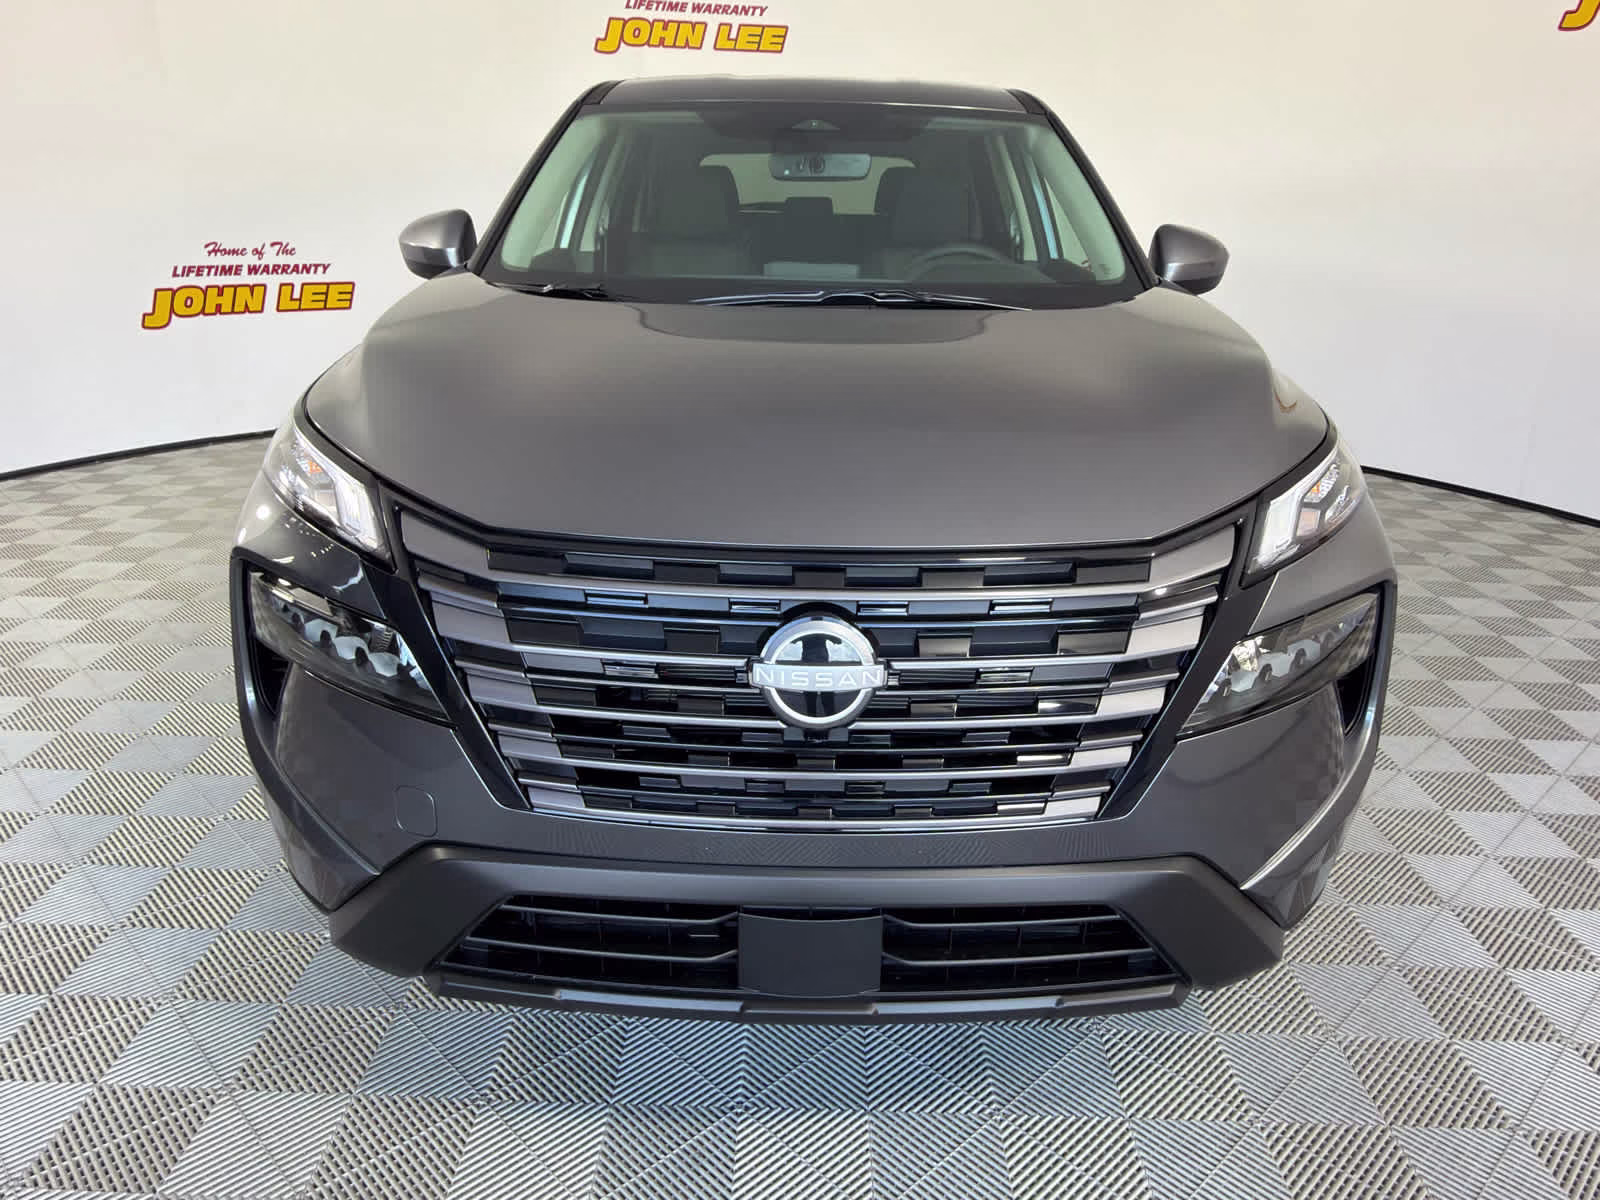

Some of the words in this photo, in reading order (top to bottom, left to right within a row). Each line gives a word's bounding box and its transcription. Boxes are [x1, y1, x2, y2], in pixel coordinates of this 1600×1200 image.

[624, 0, 688, 13] LIFETIME
[691, 3, 768, 17] WARRANTY
[594, 17, 708, 54] JOHN
[713, 22, 789, 54] LEE
[203, 241, 248, 257] Home
[251, 243, 266, 261] of
[269, 241, 297, 257] The
[171, 264, 244, 278] LIFETIME
[247, 263, 332, 276] WARRANTY
[141, 283, 267, 330] JOHN
[276, 281, 355, 313] LEE
[755, 667, 881, 688] NISSAN
